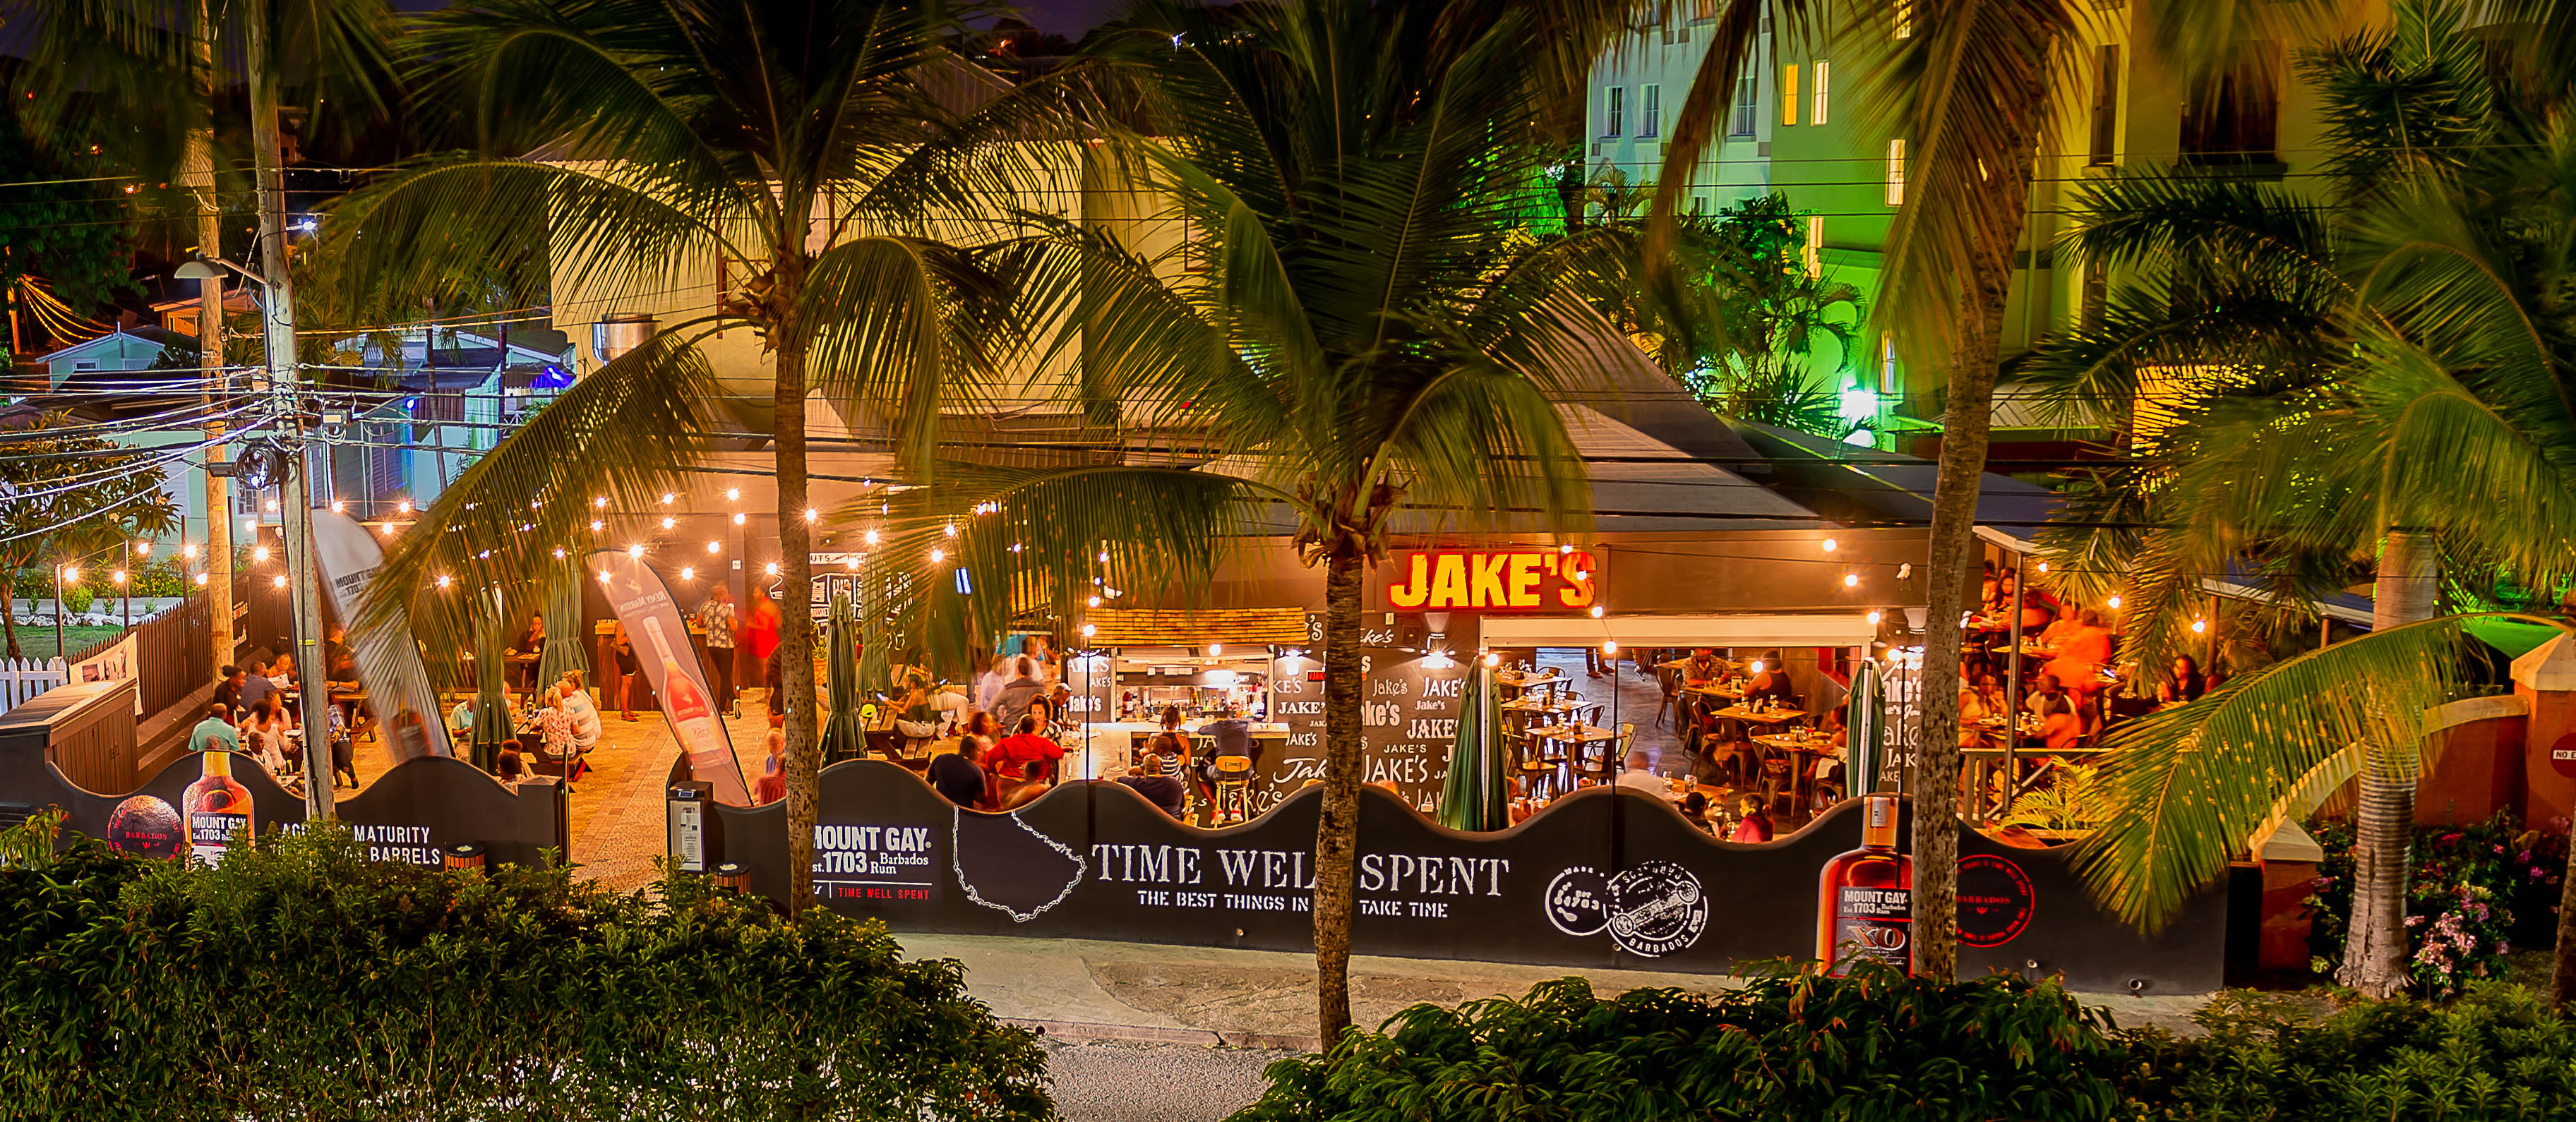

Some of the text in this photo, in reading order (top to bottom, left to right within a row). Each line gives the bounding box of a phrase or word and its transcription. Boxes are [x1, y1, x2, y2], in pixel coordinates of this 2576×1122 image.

[1389, 554, 1598, 609] JAKE'S
[1361, 629, 1394, 646] ke's
[1089, 676, 1111, 687] AKE'S
[1274, 677, 1302, 693] KE'S
[1372, 678, 1408, 696] Jake's
[1278, 701, 1326, 714] JAKE'
[1414, 700, 1446, 711] Jake's
[1406, 719, 1458, 739] JAKE'
[1285, 732, 1317, 747] JAKE'S
[1384, 744, 1427, 754] JAKE'S
[1273, 757, 1328, 783] Jak
[1362, 754, 1428, 783] JAKE'S
[191, 816, 226, 830] MOUNT
[200, 829, 221, 840] 1703
[354, 824, 430, 844] MATURITY
[885, 827, 928, 852] GAY
[371, 846, 441, 865] BARRELS
[812, 851, 929, 873] st. 1703 Barbados
[870, 861, 897, 874] Rum
[1092, 844, 1509, 896] TIME WEL SPENT
[837, 887, 930, 900] TIME WELL SPENT
[1844, 890, 1907, 905] MOUNT GAY
[1137, 890, 1449, 918] THE BEST THINGS IN TAKE TIME
[1852, 903, 1876, 914] 1703
[1629, 934, 1689, 953] BARBADOS
[1845, 924, 1906, 951] XO
